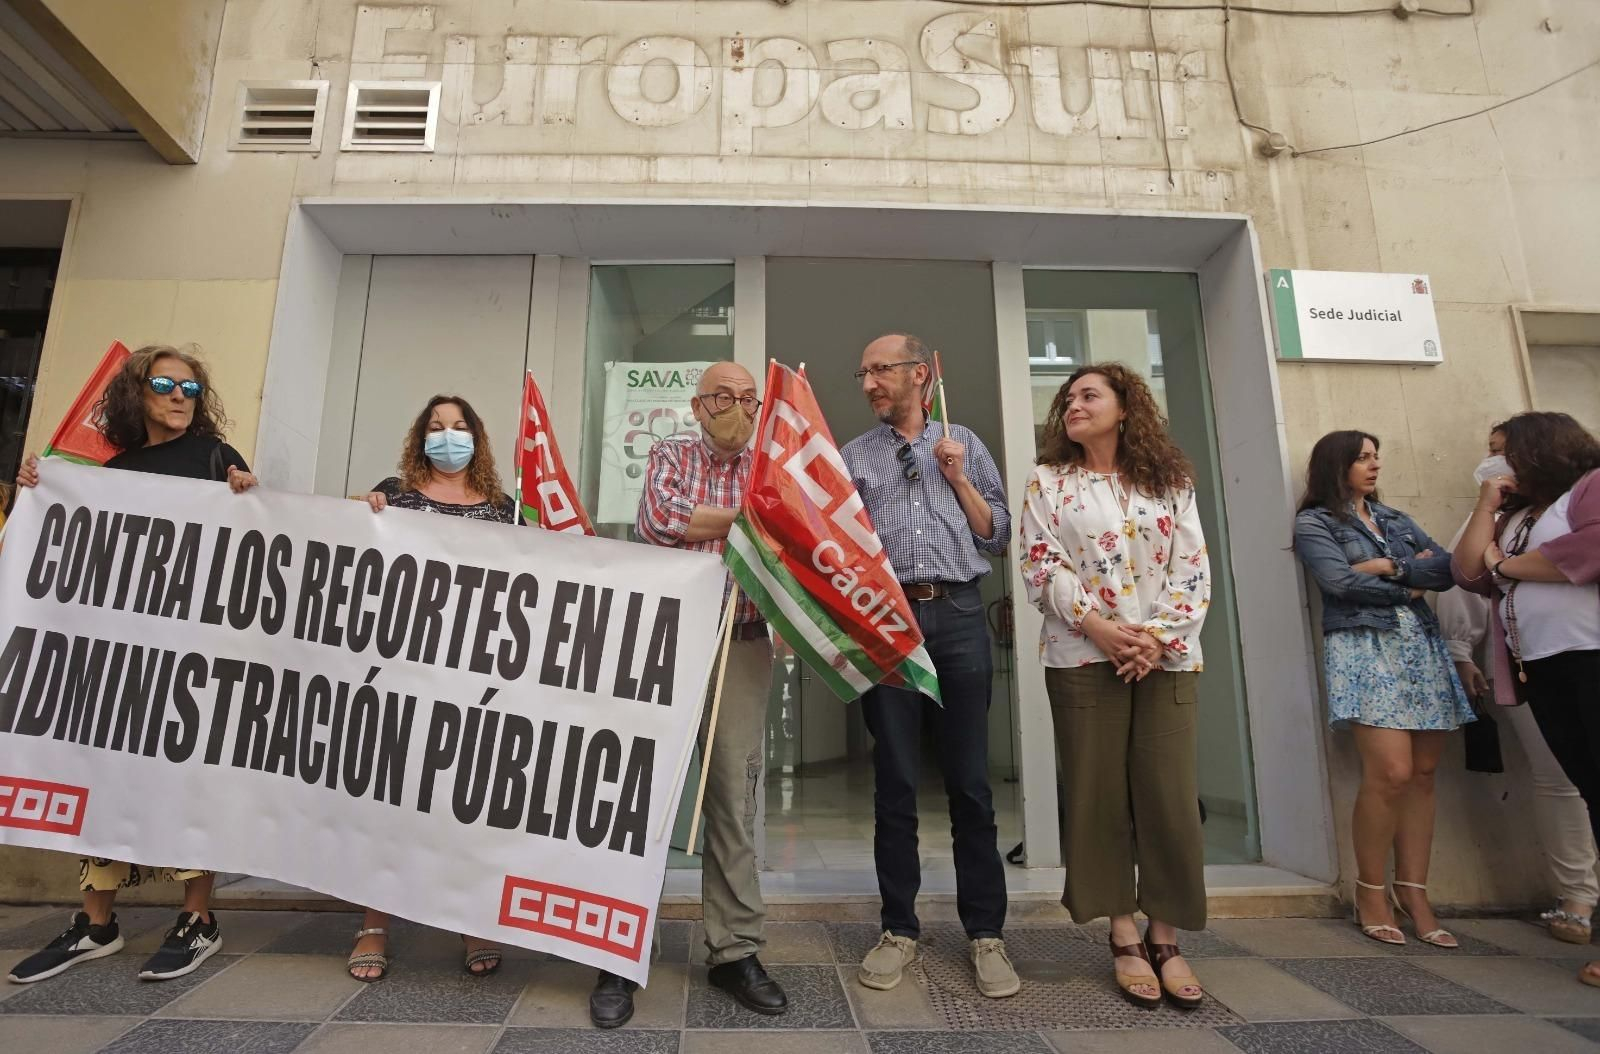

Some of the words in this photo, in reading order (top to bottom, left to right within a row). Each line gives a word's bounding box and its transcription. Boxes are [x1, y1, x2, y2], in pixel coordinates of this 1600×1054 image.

[1309, 307, 1344, 320] Sede
[1347, 310, 1403, 322] Judicial
[627, 369, 685, 388] SAVA
[26, 502, 203, 620] CONTRA
[200, 526, 293, 635] LOS
[294, 540, 540, 681] RECORTES
[539, 580, 614, 694] EN
[612, 591, 681, 706] LA
[811, 539, 909, 644] Cádiz
[0, 625, 418, 807] ADMINISTRACIÓN
[416, 687, 656, 858] PÚBLICA
[509, 886, 641, 949] CCOO
